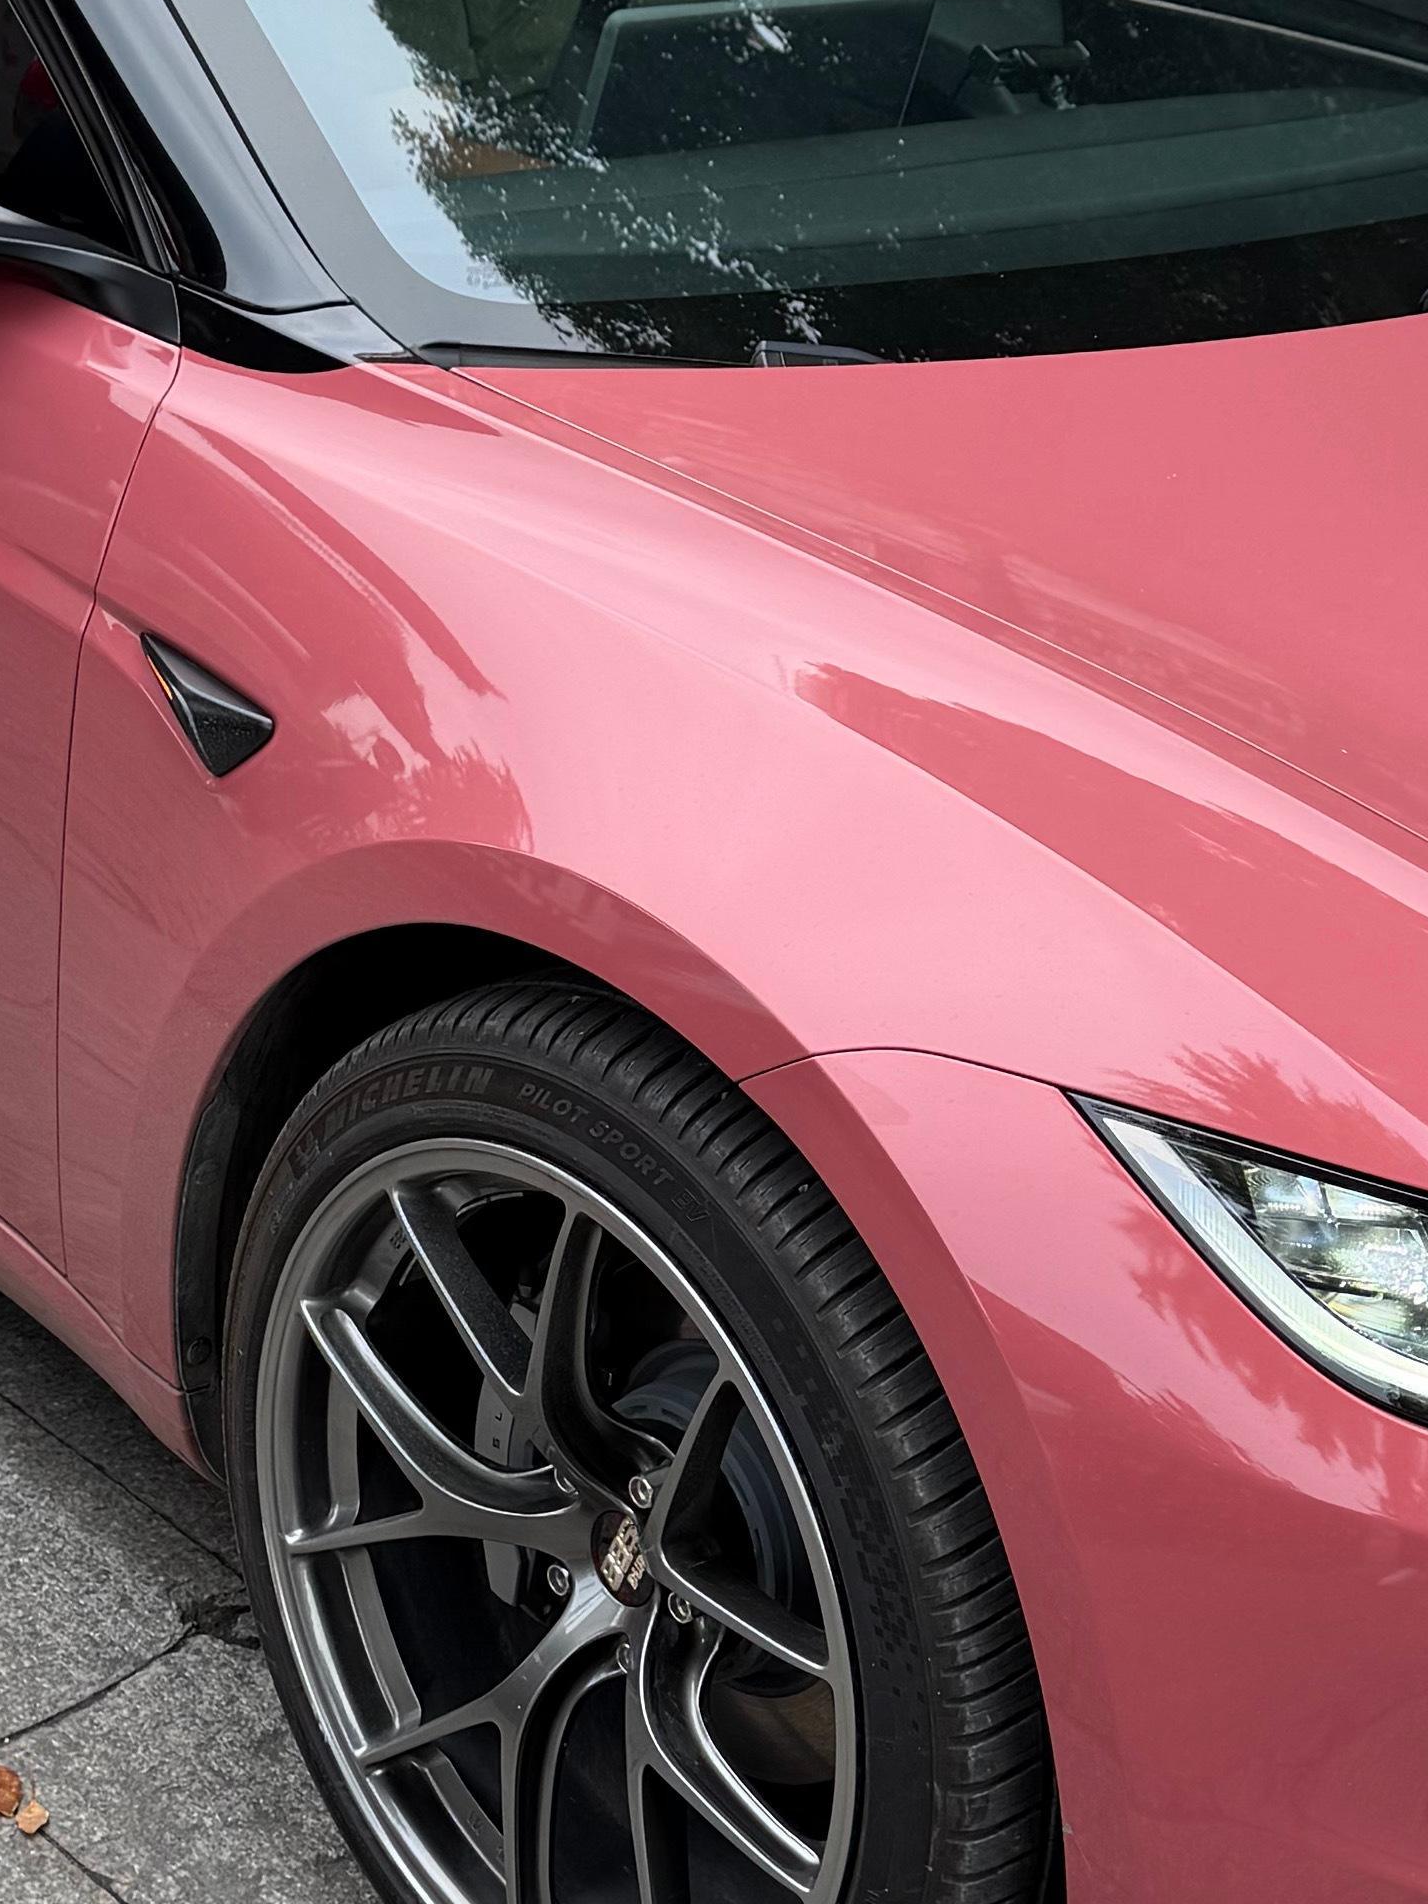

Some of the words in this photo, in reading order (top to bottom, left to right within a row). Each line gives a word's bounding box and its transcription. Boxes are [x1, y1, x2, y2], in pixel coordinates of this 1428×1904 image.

[324, 1066, 494, 1142] MICHELIN
[517, 1083, 590, 1124] PILOT
[588, 1119, 674, 1185] SPORT
[671, 1187, 710, 1223] EV
[600, 1516, 640, 1592] BBS
